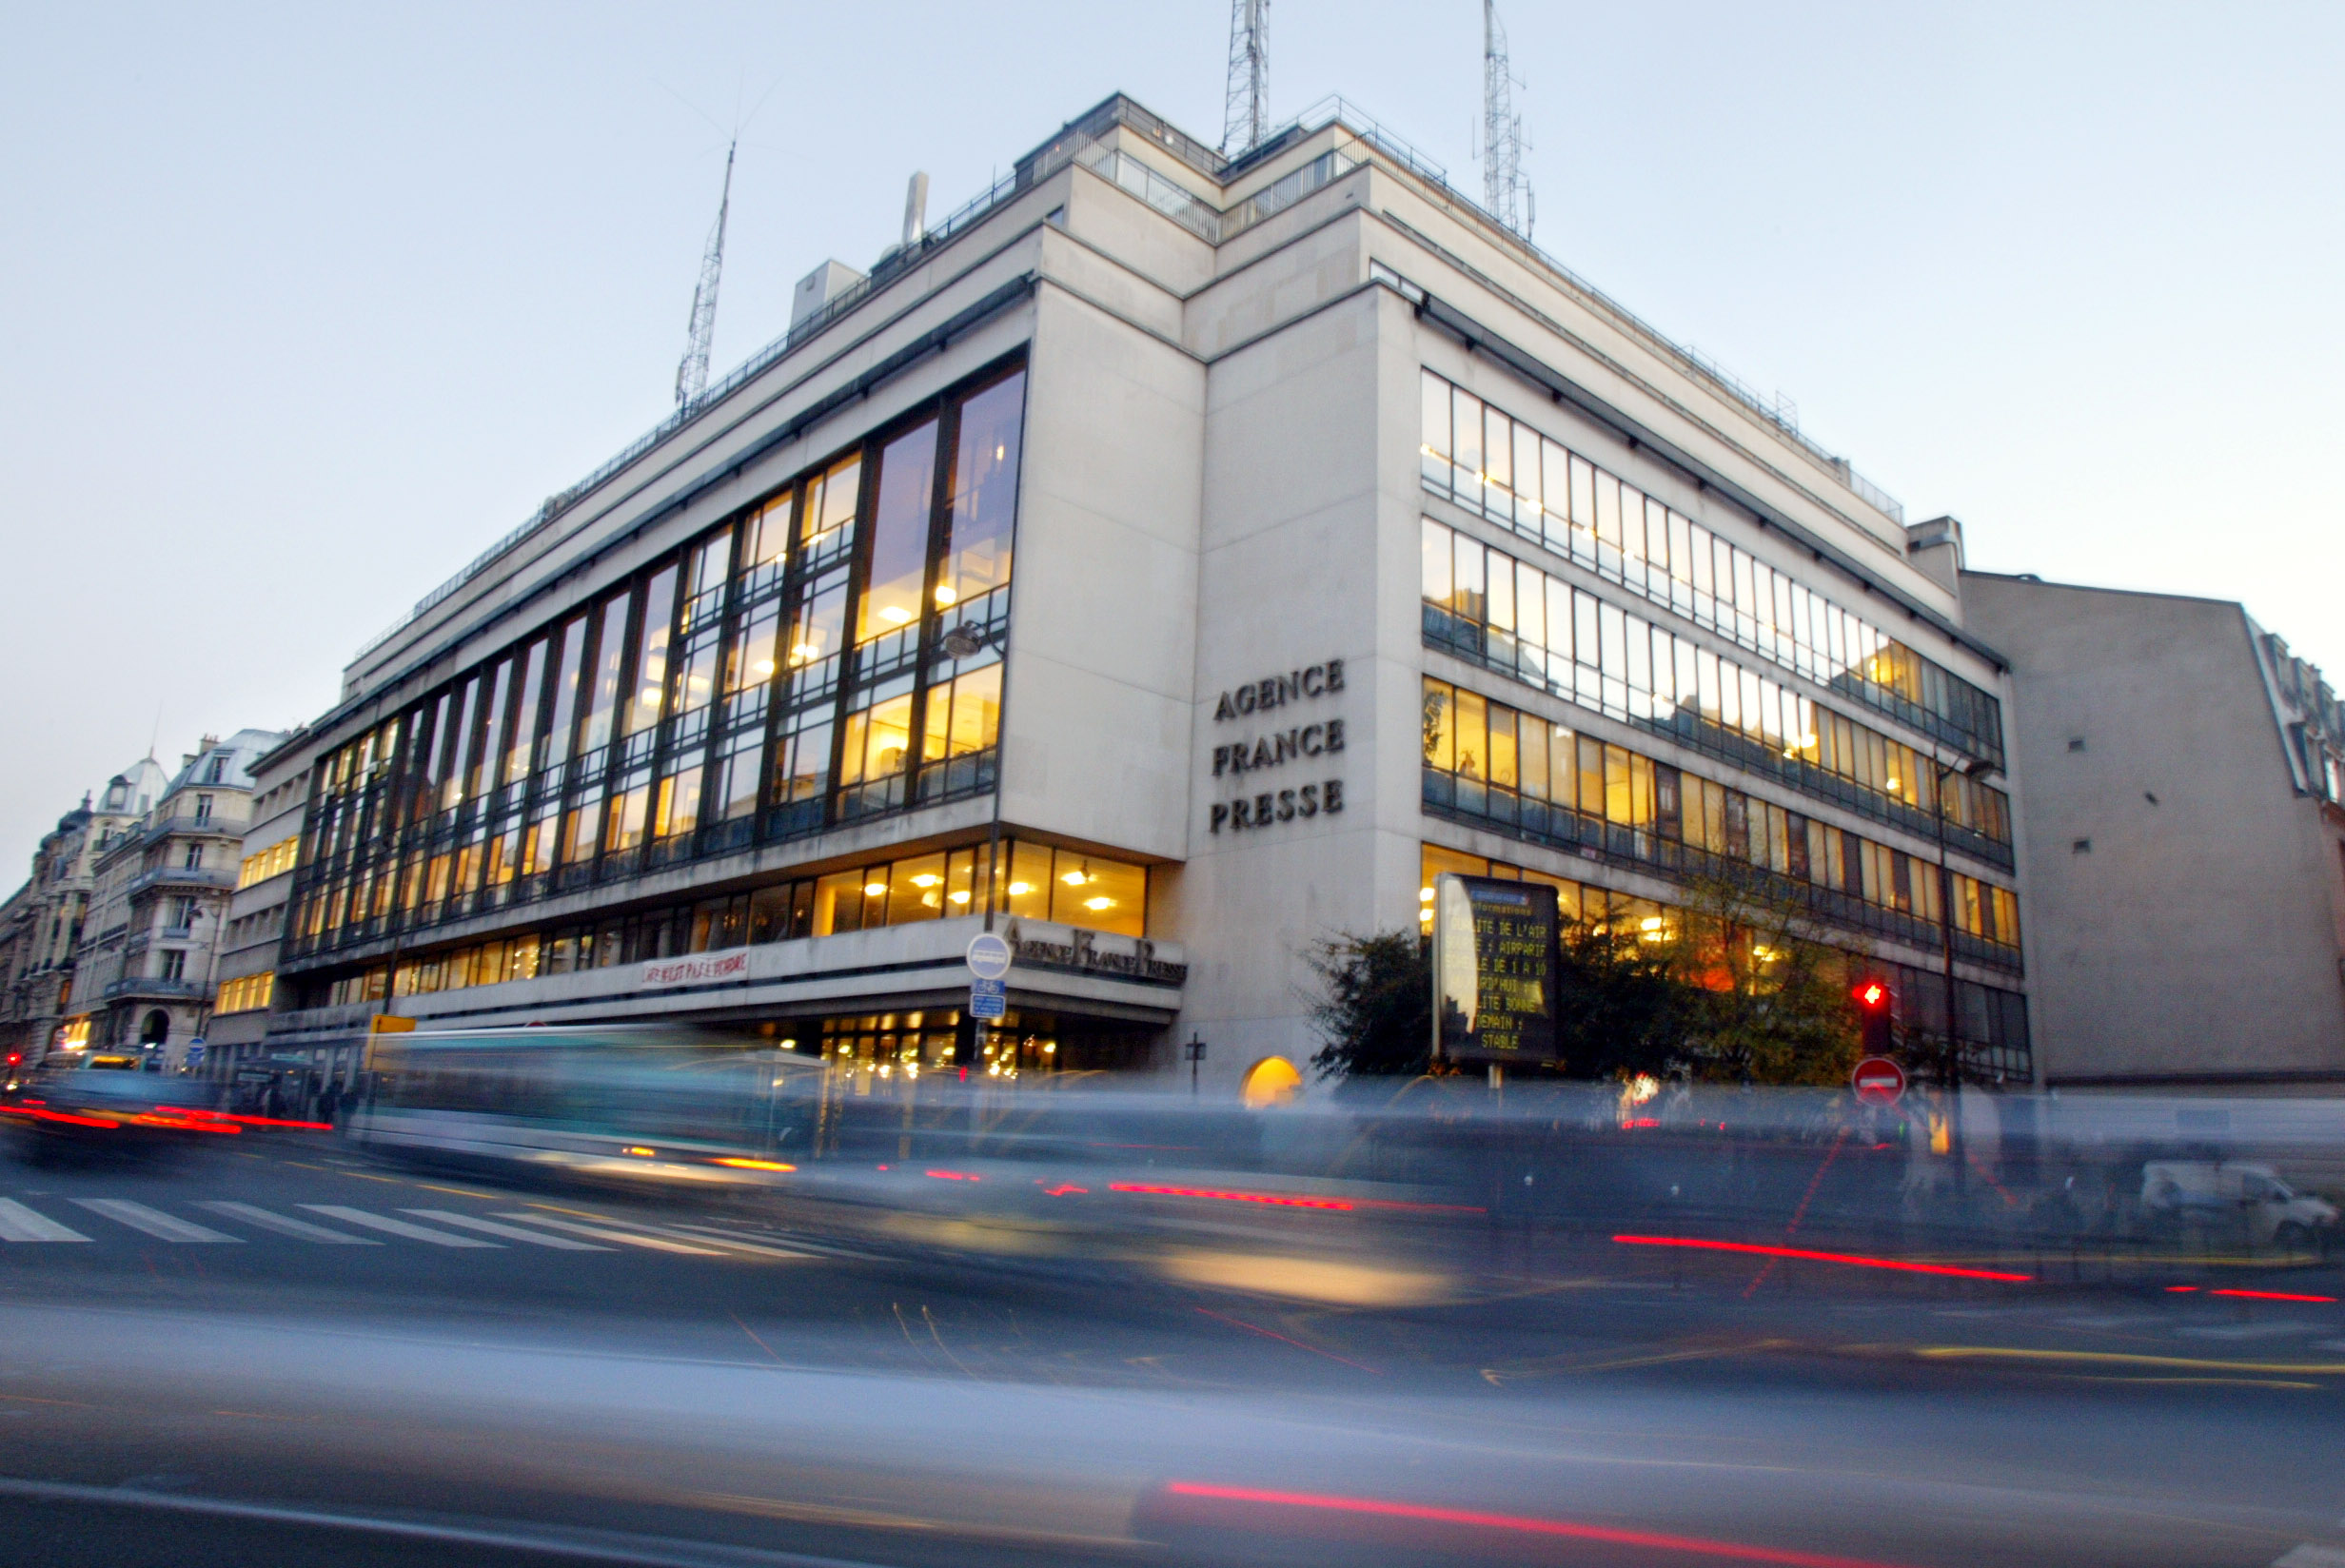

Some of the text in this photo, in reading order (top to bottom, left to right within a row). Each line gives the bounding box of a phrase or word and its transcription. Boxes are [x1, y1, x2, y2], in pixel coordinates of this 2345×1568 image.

[1213, 658, 1345, 721] AGENCE
[1212, 718, 1345, 779] FRANCE
[1209, 778, 1343, 835] PRESSE
[1481, 1031, 1520, 1050] STABLE
